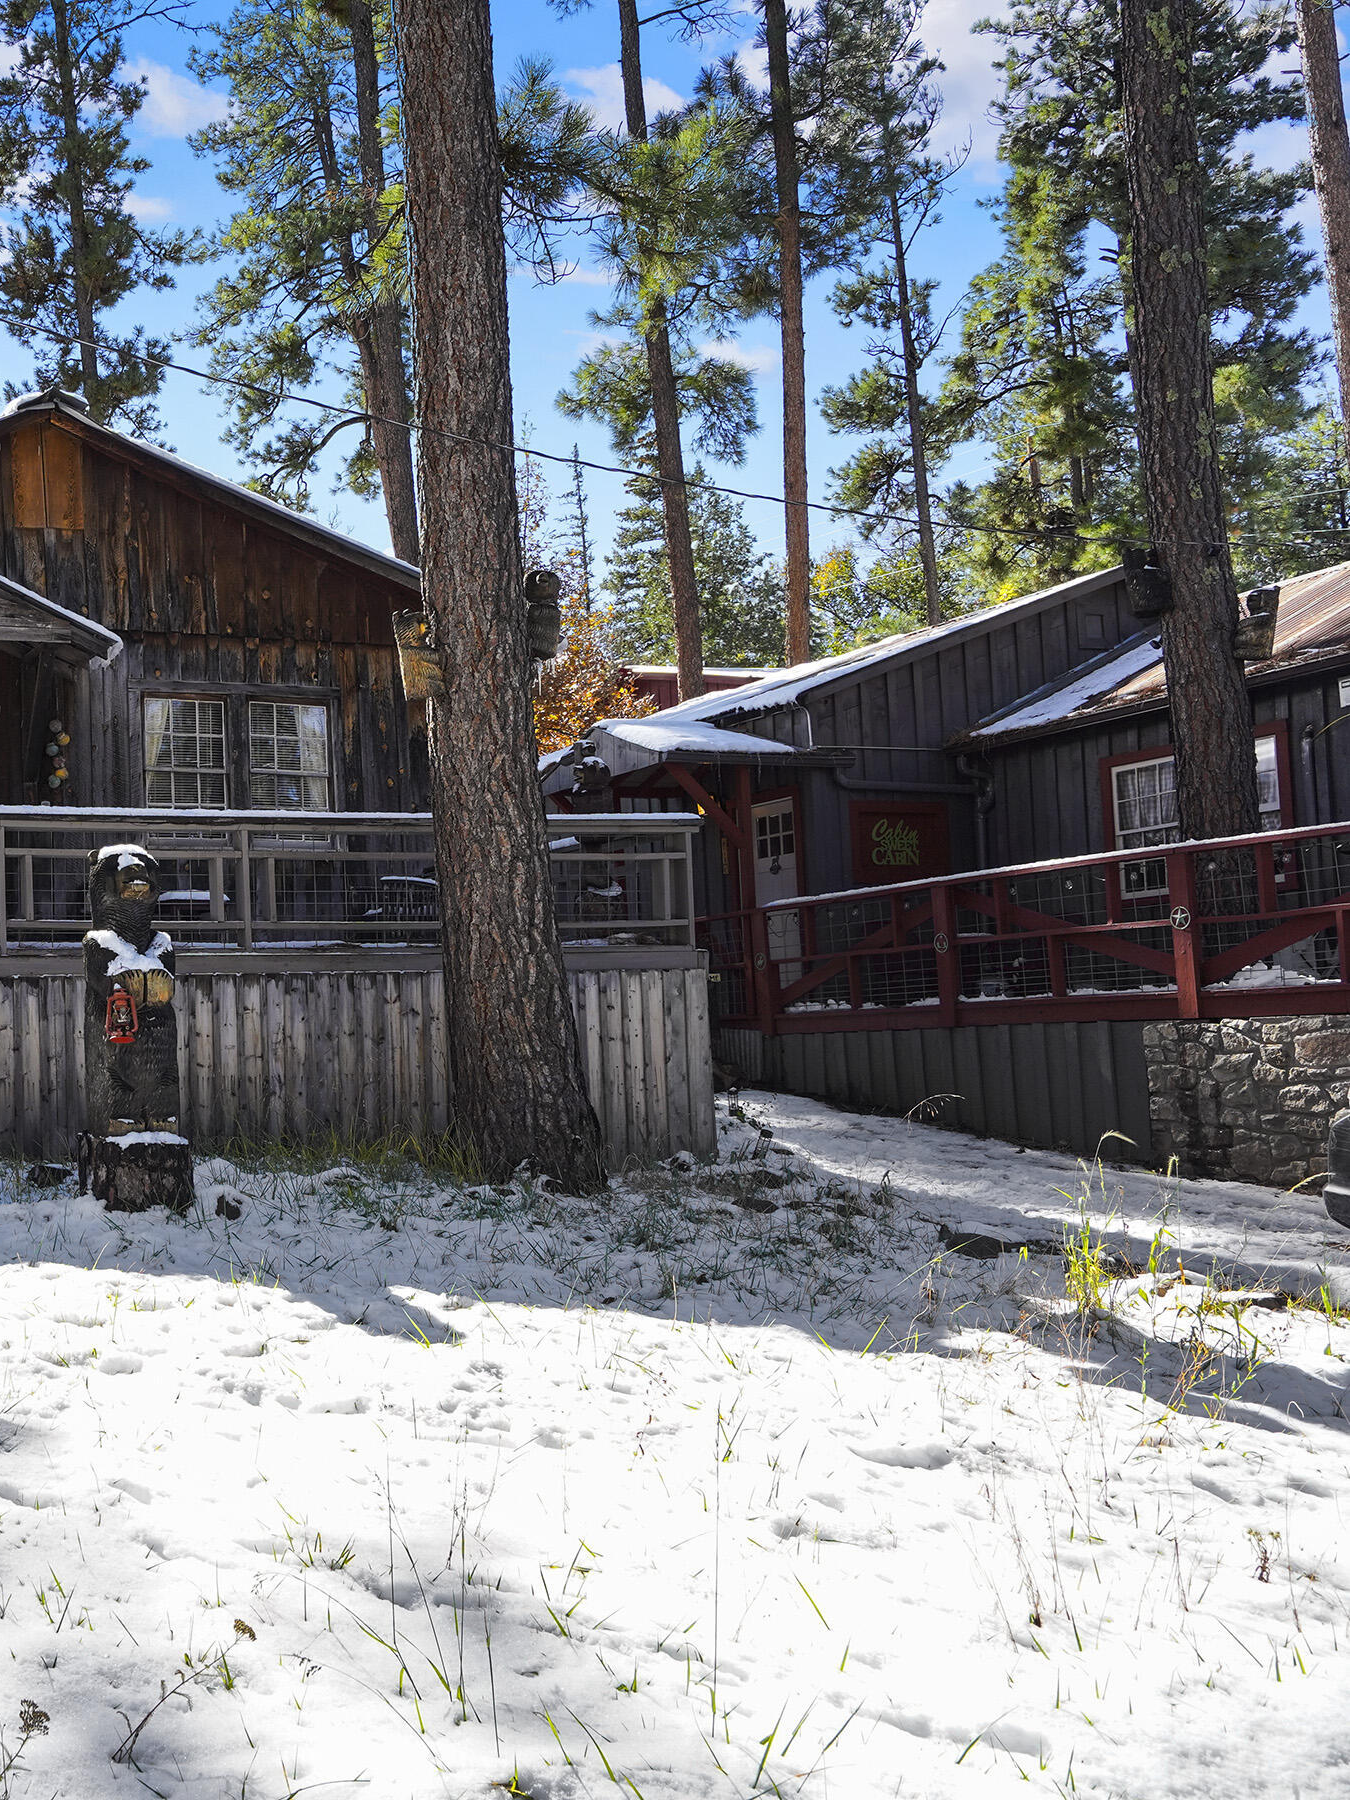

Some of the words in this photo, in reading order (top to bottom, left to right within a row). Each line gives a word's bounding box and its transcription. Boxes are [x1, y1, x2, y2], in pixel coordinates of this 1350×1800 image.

[871, 818, 918, 841] Cabin
[880, 838, 919, 851] SWEET
[871, 847, 921, 866] CABIN
